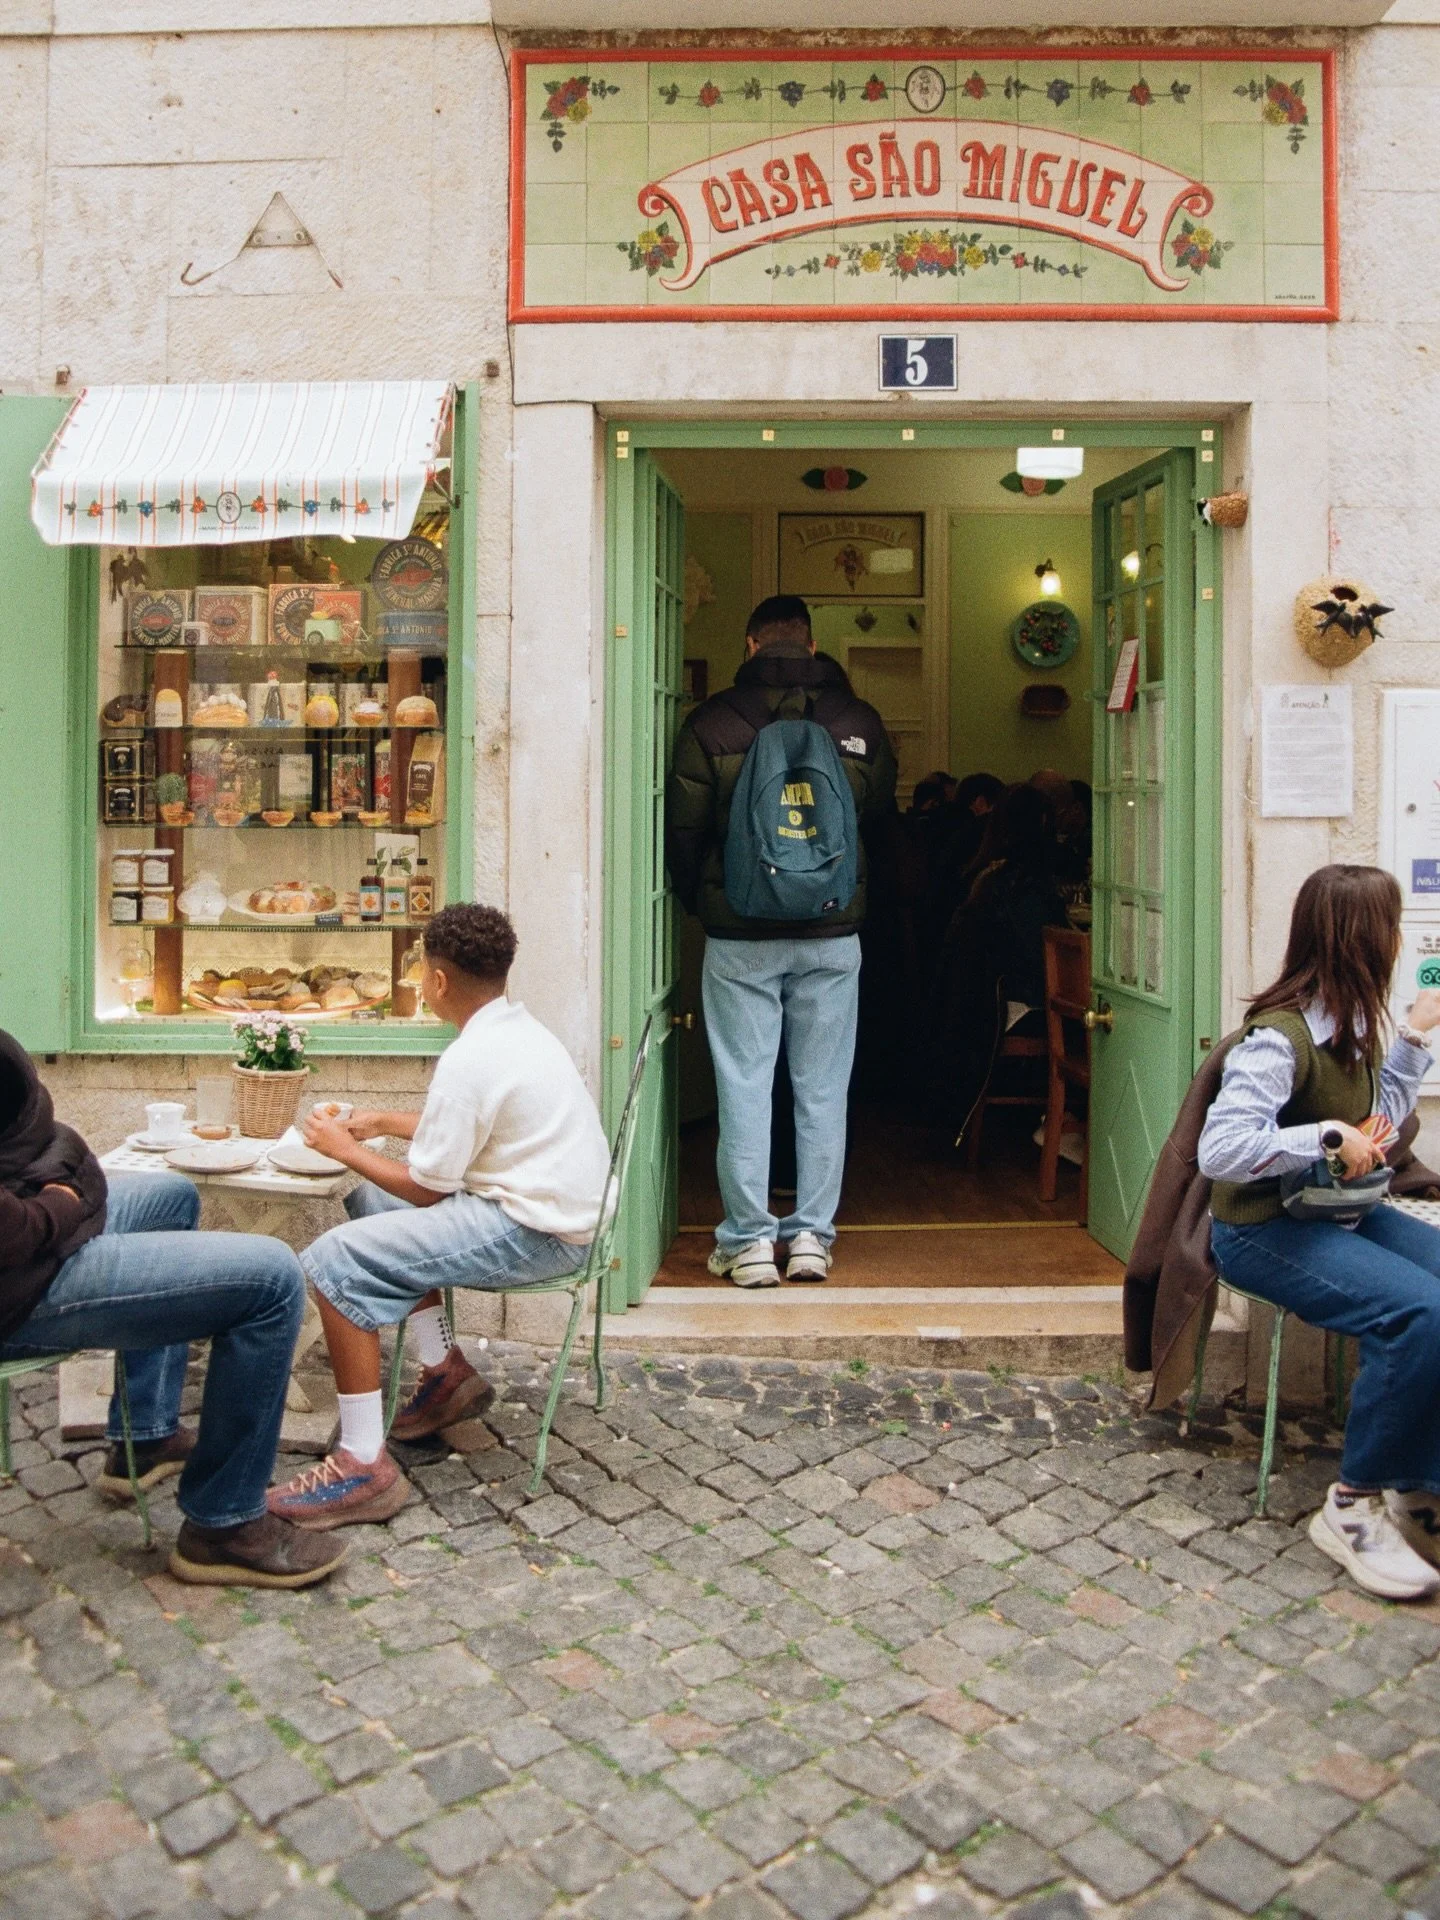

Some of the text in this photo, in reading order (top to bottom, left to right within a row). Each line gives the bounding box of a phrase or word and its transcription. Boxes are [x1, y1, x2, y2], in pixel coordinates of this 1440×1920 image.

[701, 131, 1147, 238] CASA SÃO MIGUEL
[905, 339, 928, 386] 5
